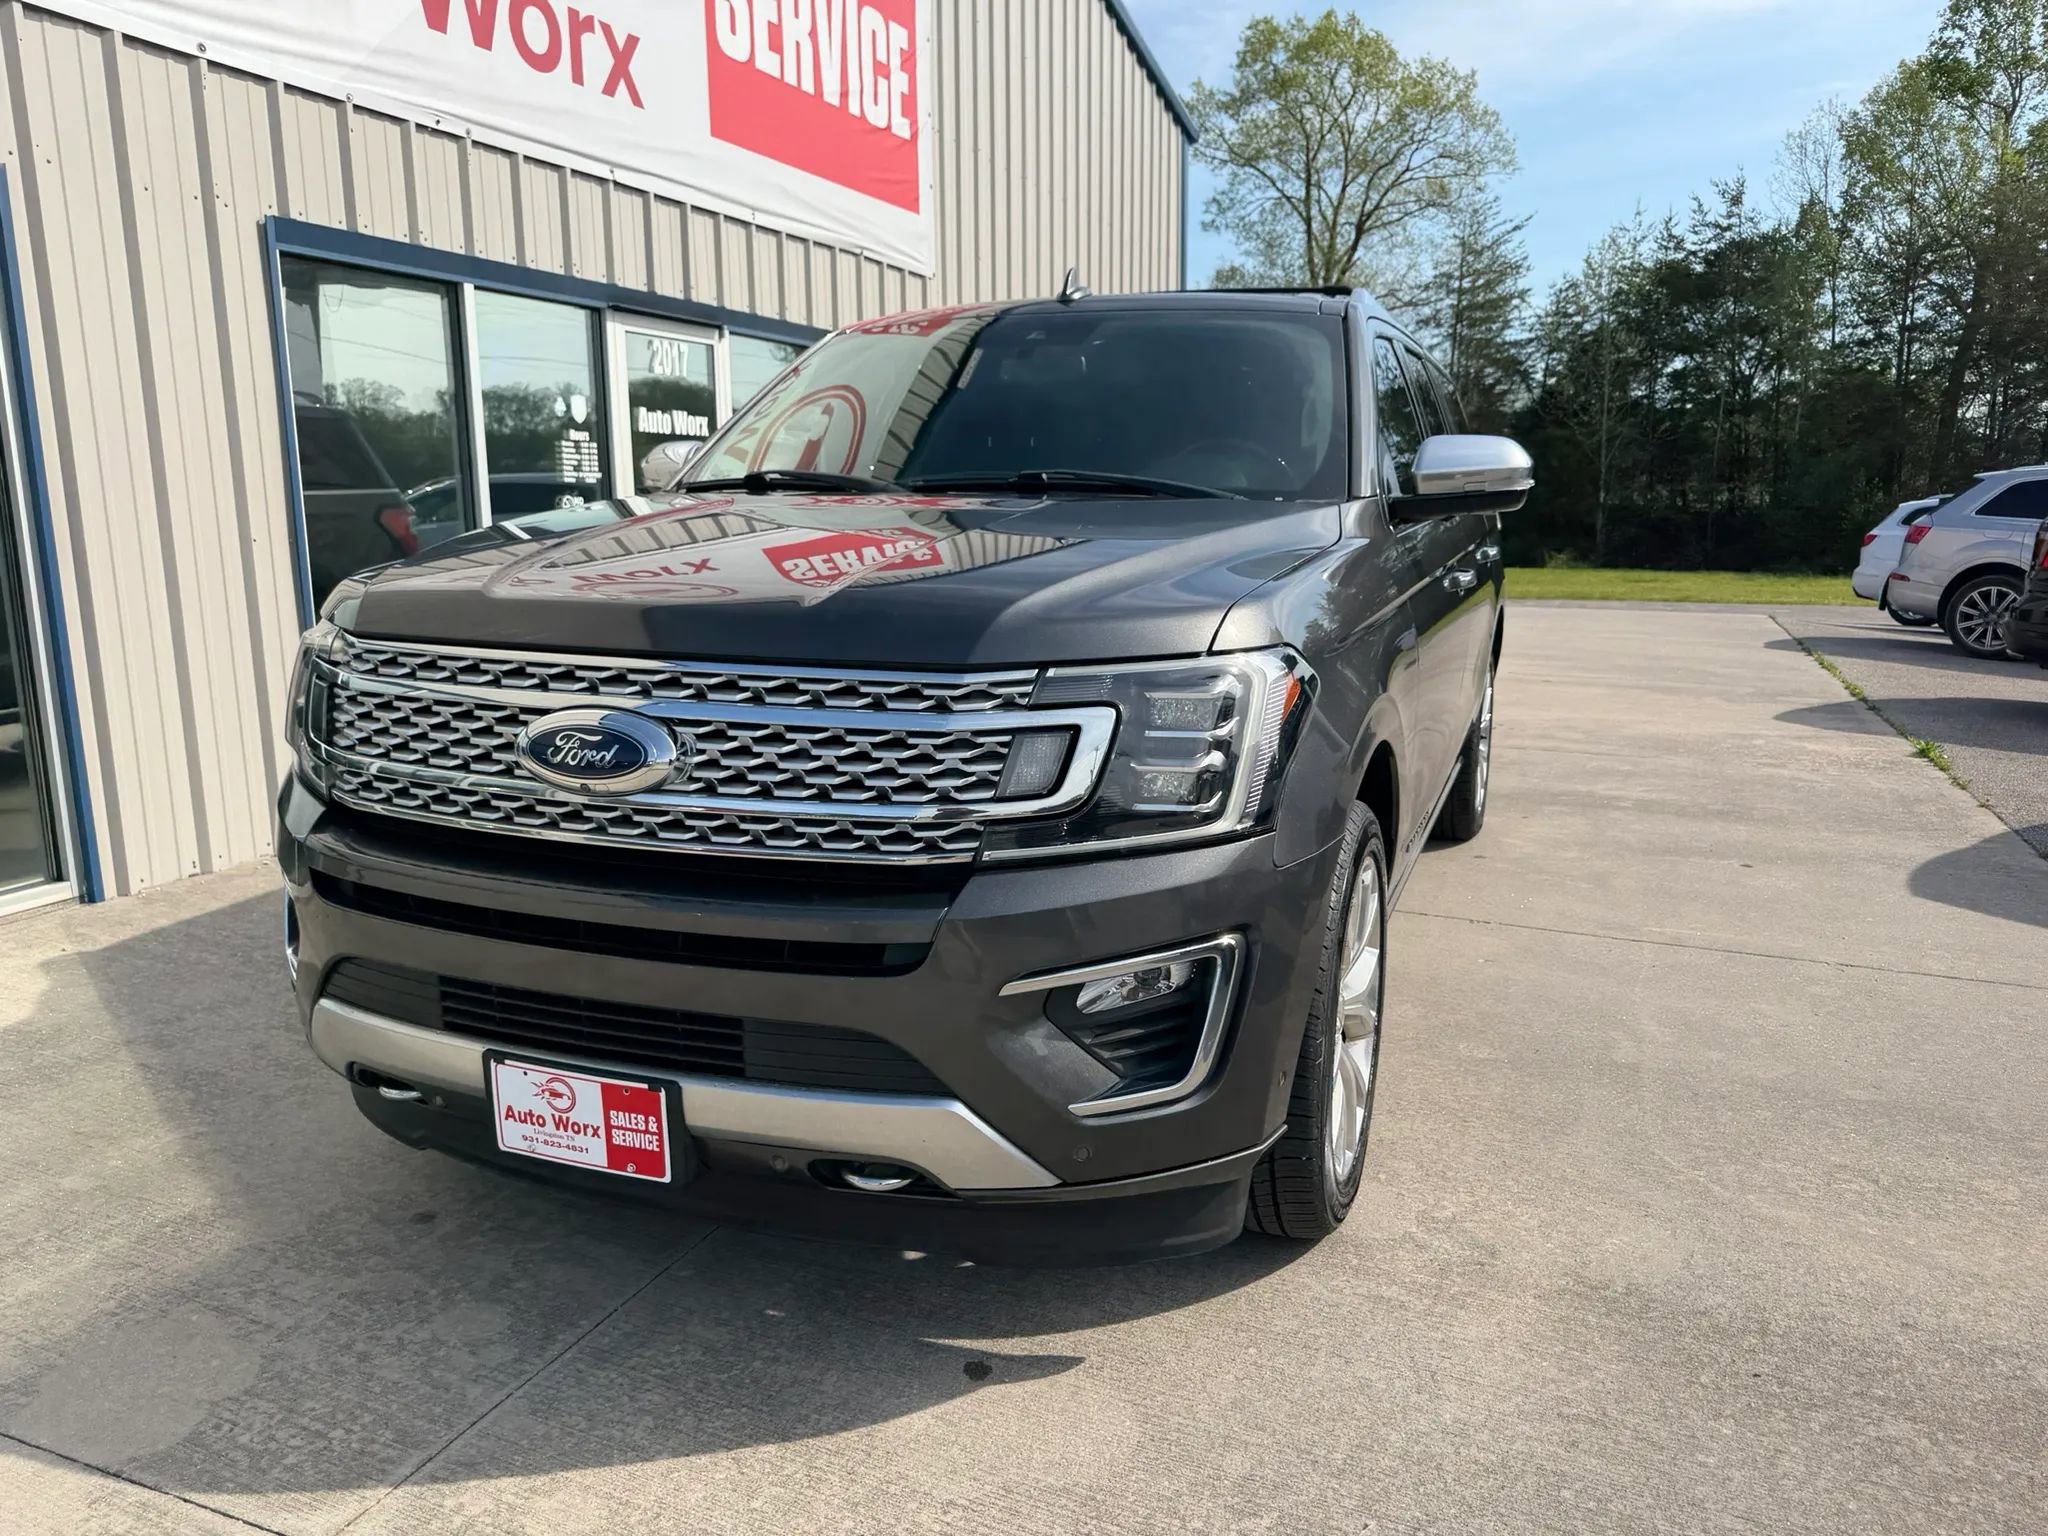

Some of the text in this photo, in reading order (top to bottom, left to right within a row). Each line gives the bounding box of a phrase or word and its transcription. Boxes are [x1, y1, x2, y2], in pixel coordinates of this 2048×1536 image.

[652, 339, 689, 377] 2017
[638, 405, 709, 437] Auto Worx
[547, 731, 619, 768] Ford
[504, 1104, 602, 1139] Auto Worx
[610, 1109, 659, 1132] SALES &
[612, 1130, 660, 1151] SERVICE
